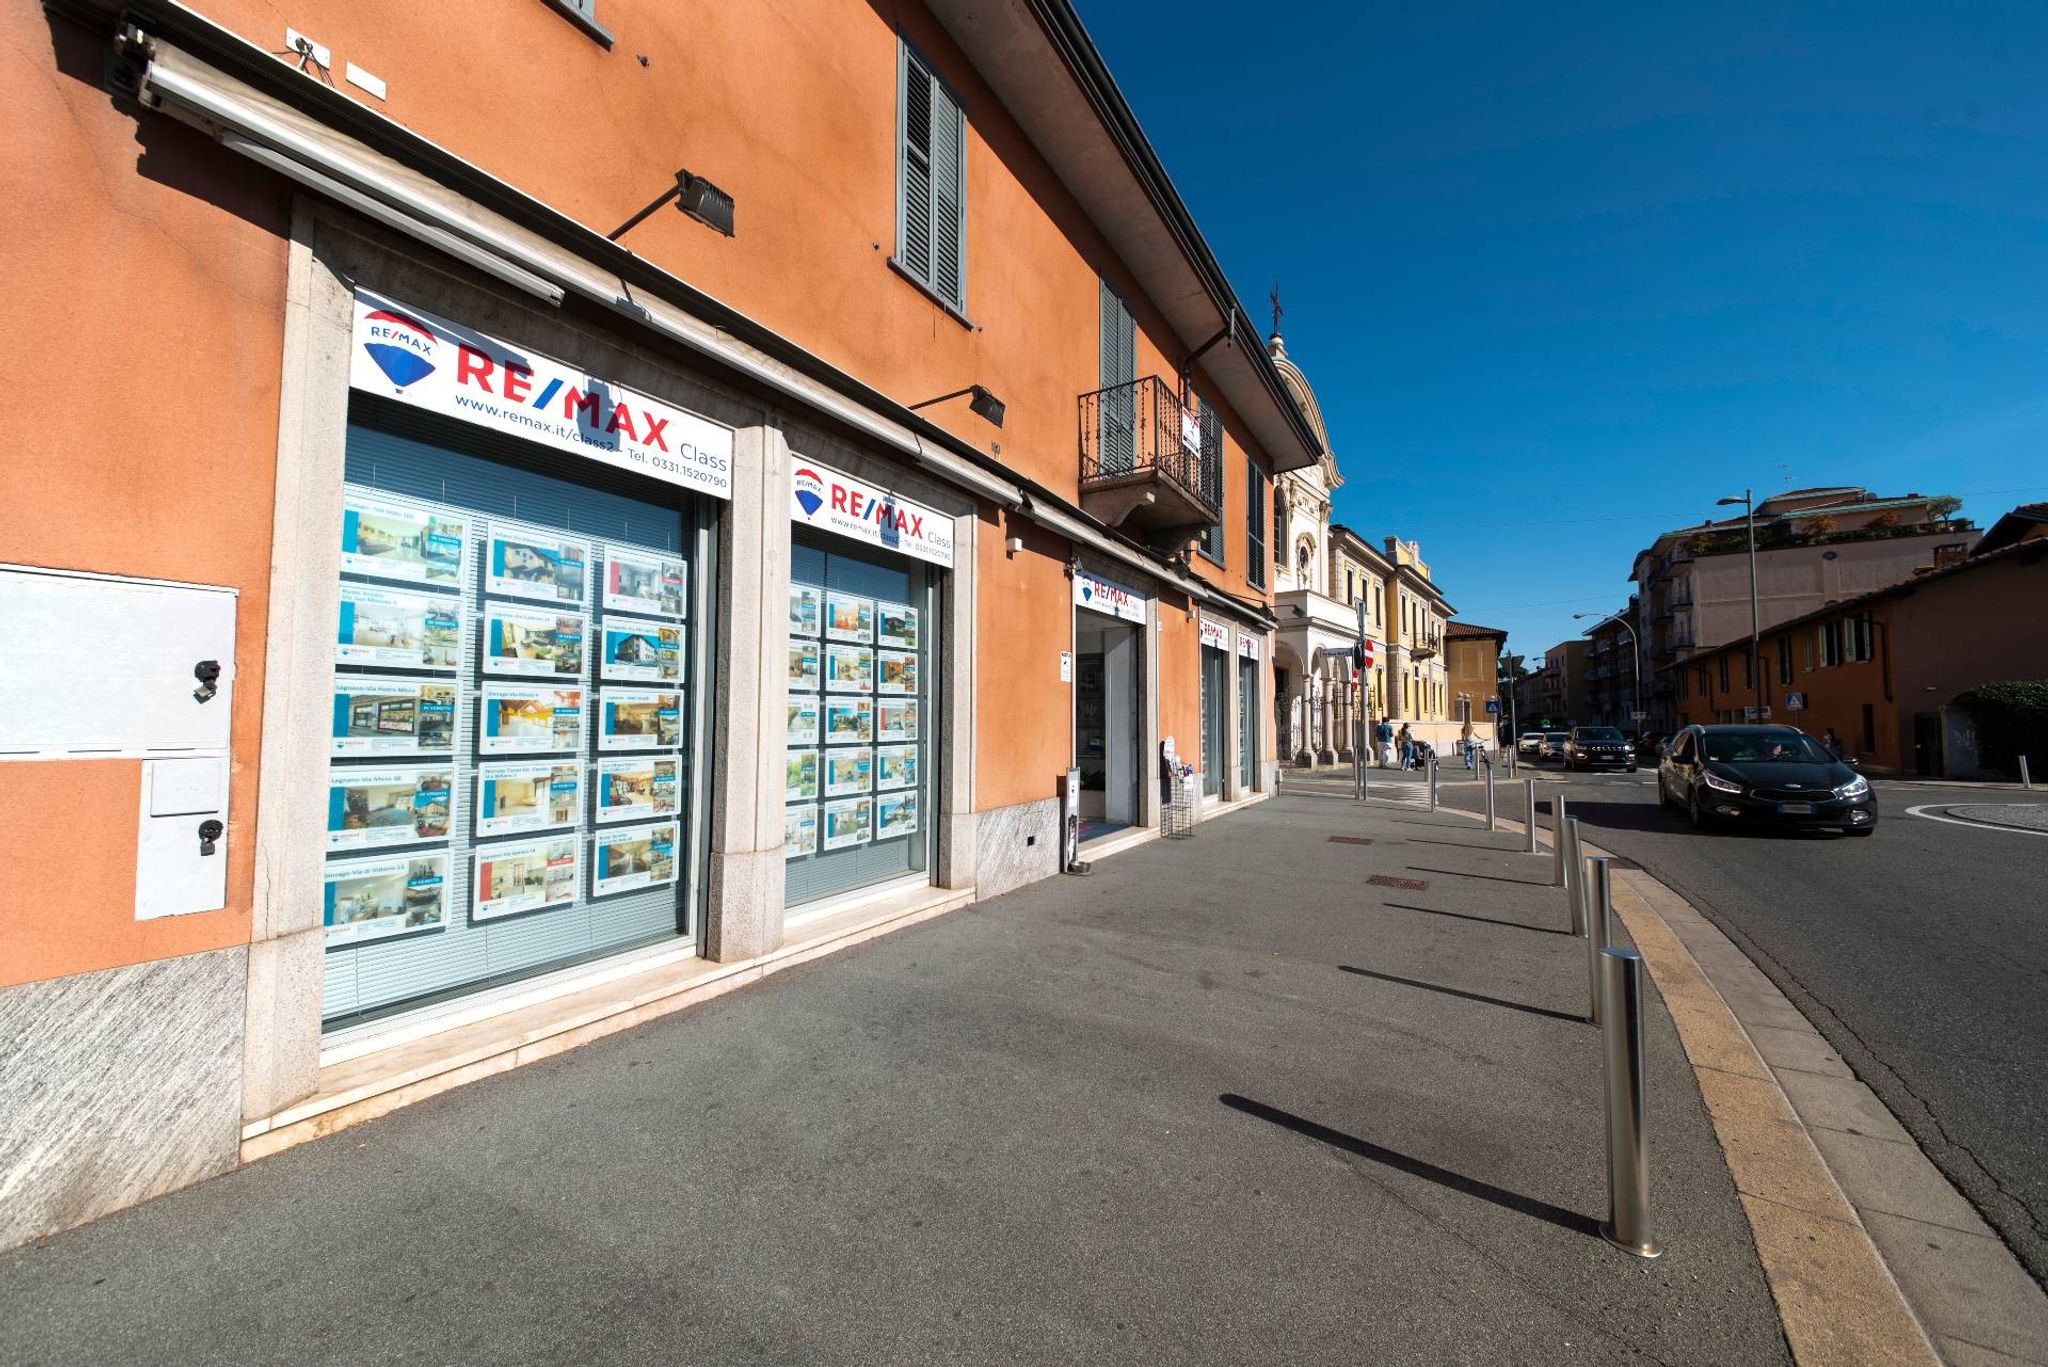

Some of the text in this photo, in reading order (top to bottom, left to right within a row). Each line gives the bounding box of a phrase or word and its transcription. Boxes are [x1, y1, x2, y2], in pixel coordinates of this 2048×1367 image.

[371, 326, 432, 356] RE/MAX
[457, 342, 728, 472] RE/MAX Class
[455, 395, 614, 453] www.remax.it/class2
[627, 447, 649, 464] Tel.
[652, 456, 728, 488] 0331.1520790
[831, 483, 952, 550] RE/MAX Class
[1094, 582, 1129, 607] RE/MAX
